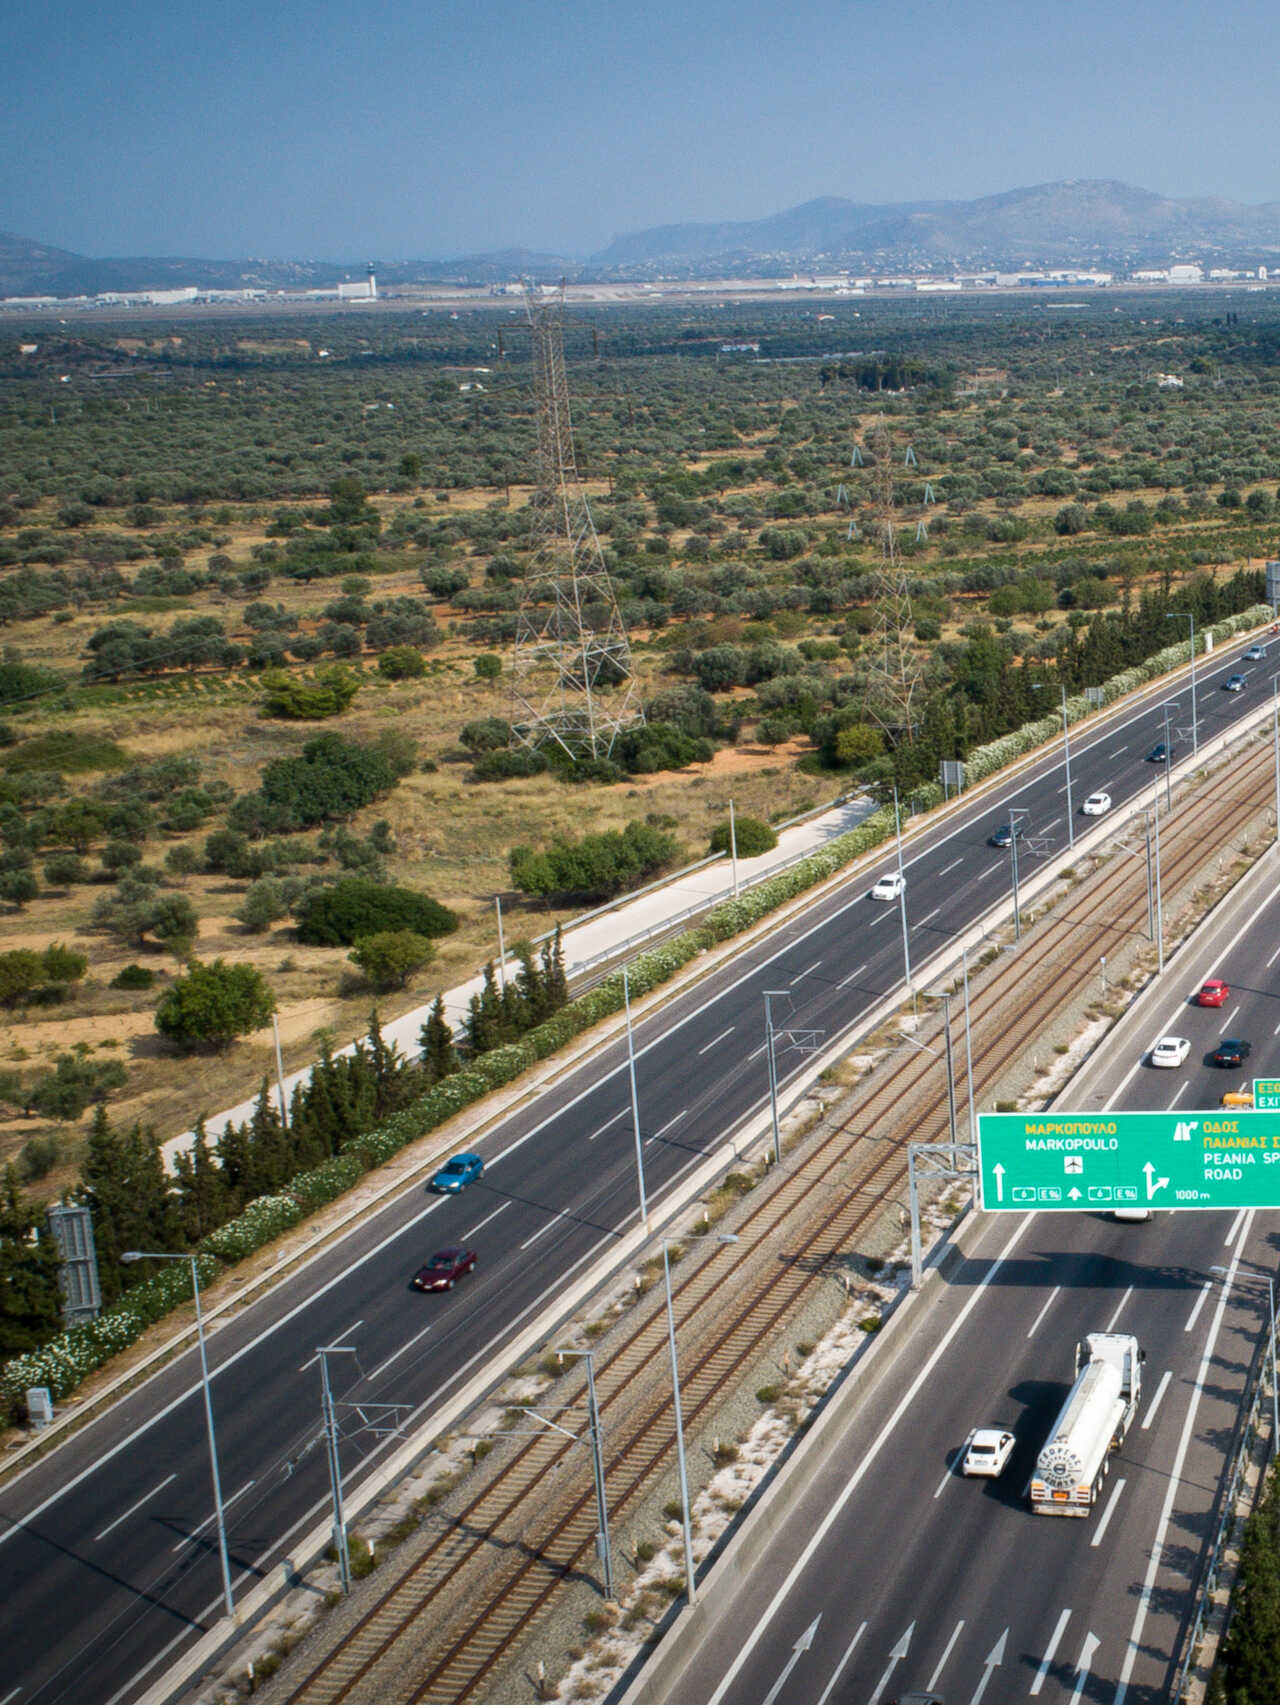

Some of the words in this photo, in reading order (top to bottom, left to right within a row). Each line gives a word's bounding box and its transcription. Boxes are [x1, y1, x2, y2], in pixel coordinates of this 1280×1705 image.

[1025, 1122, 1117, 1135] ΜΑΡΚΟΠΟΥΛΟ
[1203, 1121, 1239, 1133] ΟΔΟΣ
[1025, 1138, 1118, 1151] MARKOPOULO
[1203, 1136, 1268, 1148] ΠΑΙΑΝΙΑΣ
[1204, 1152, 1256, 1165] PEANIA
[1204, 1168, 1242, 1180] ROAD
[1175, 1189, 1199, 1200] 1000
[1200, 1192, 1210, 1200] m
